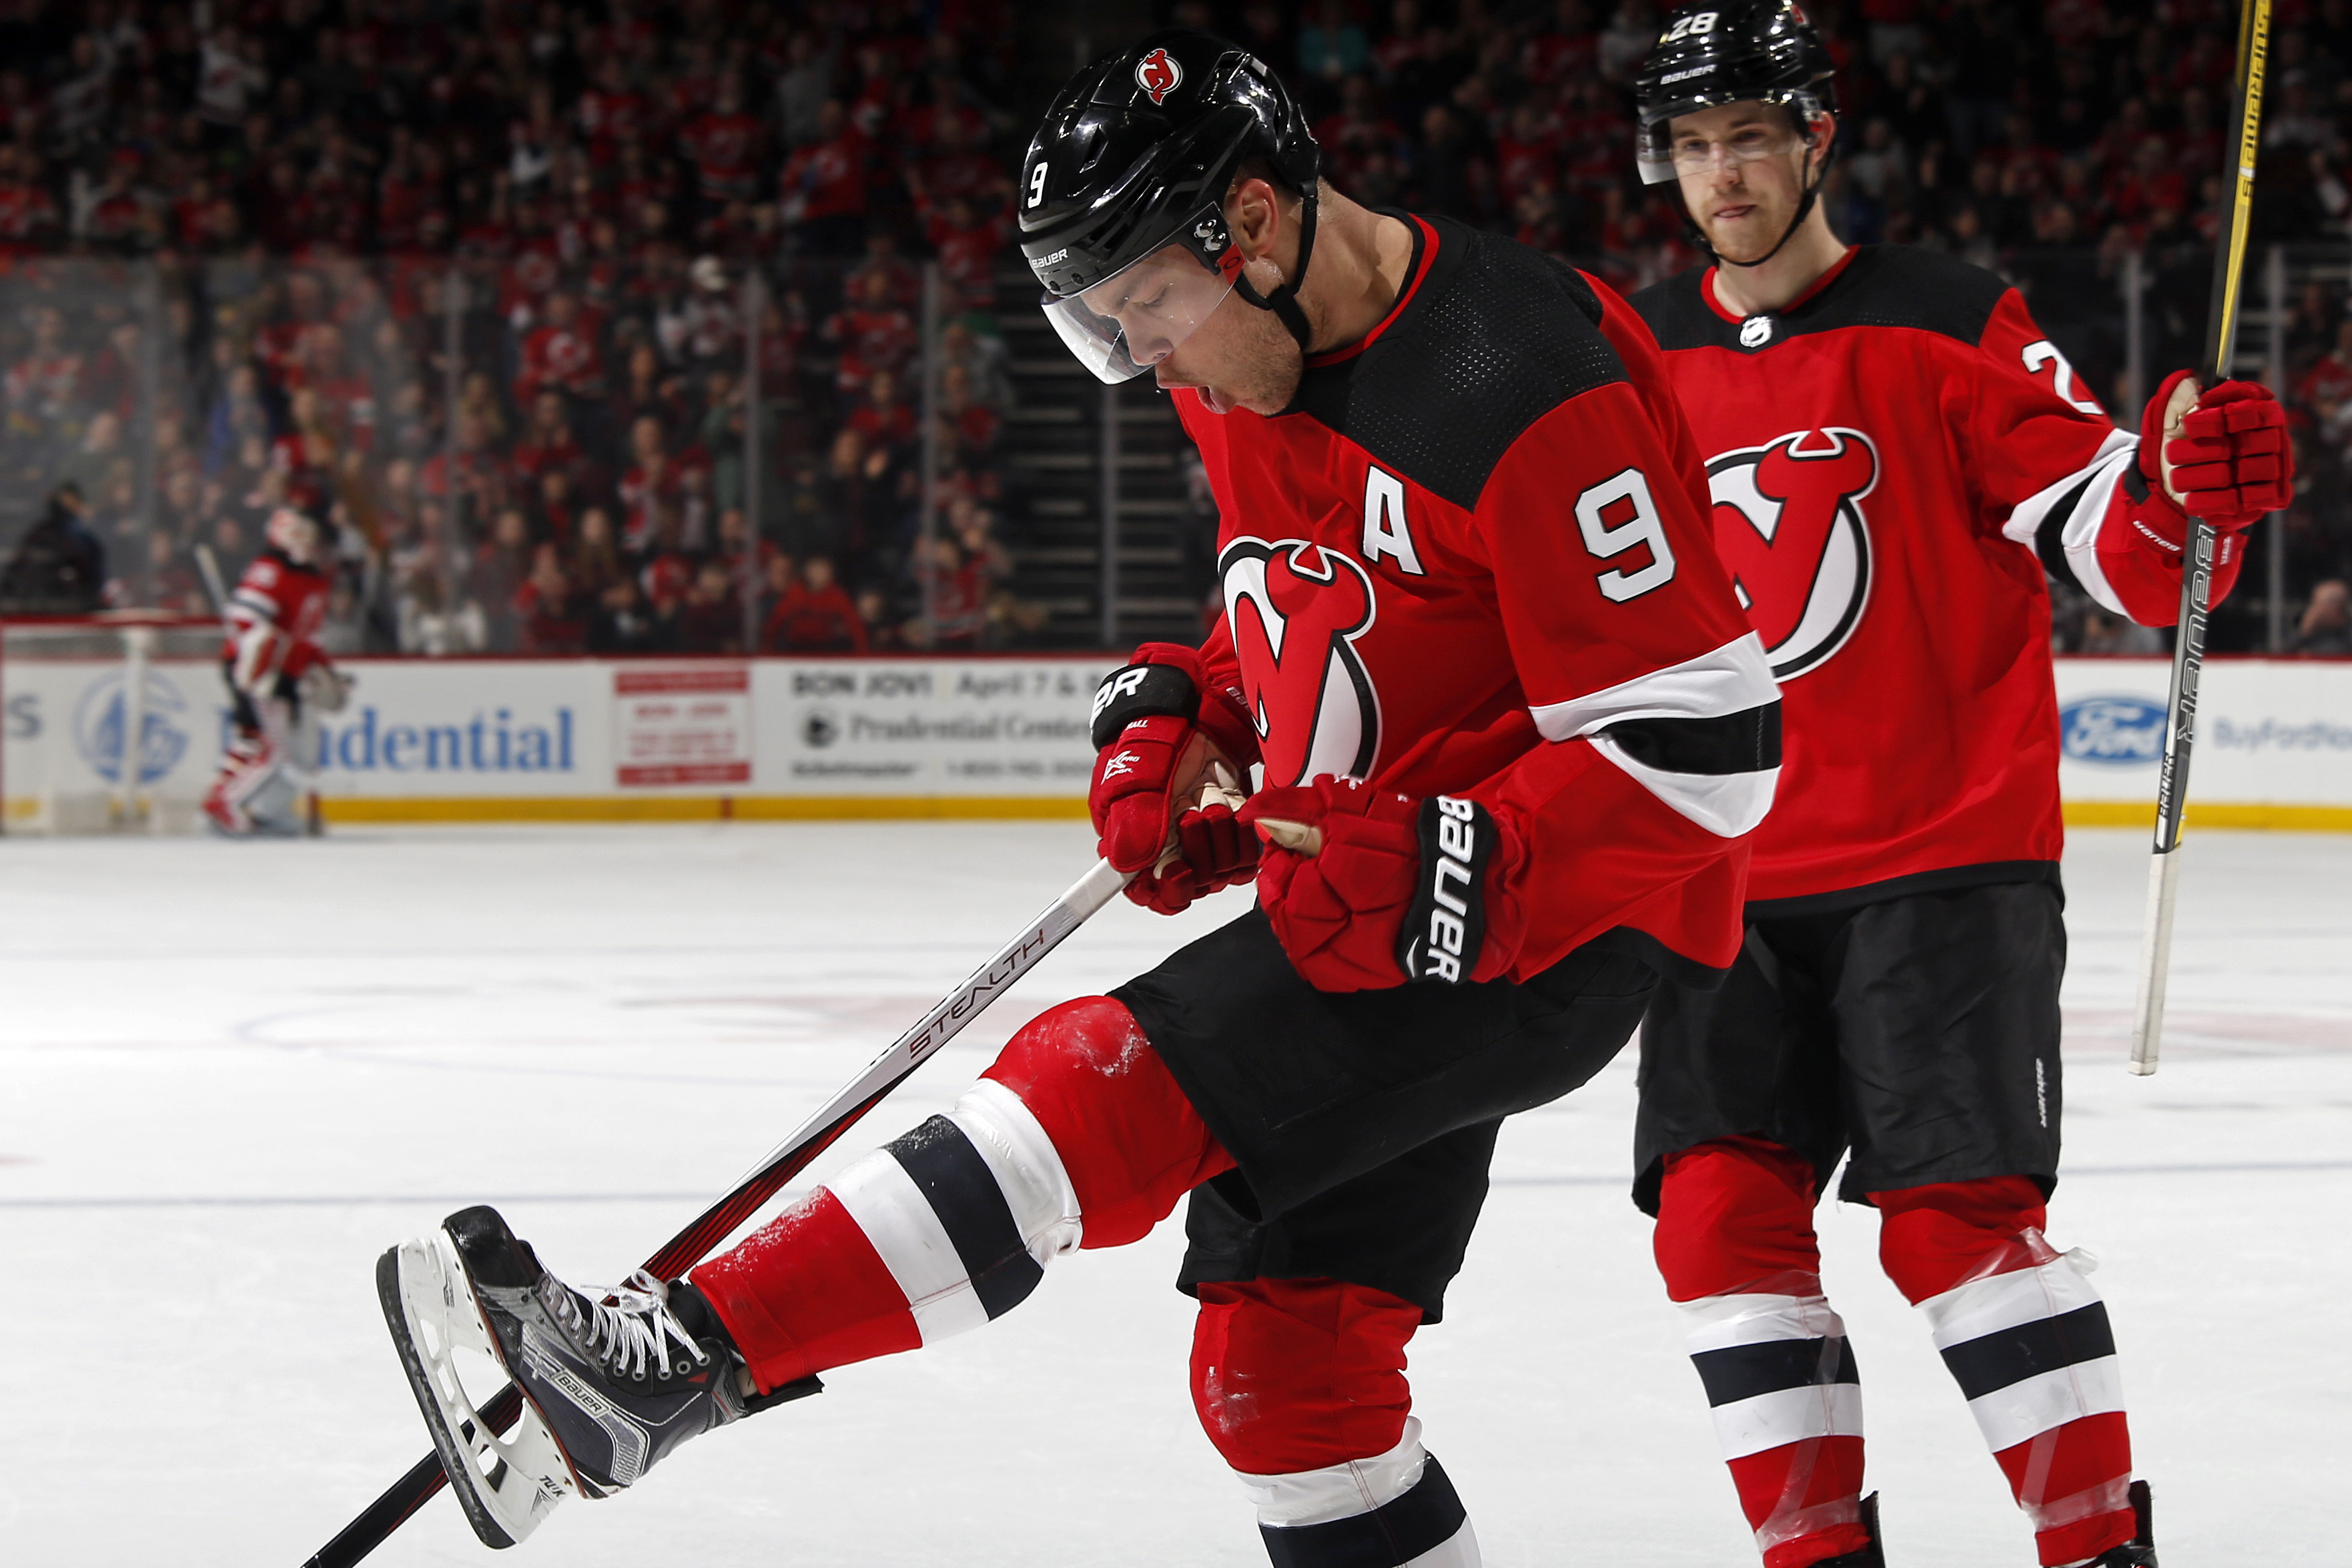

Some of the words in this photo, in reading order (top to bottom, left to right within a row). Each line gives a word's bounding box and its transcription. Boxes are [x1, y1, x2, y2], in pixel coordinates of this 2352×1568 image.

[1667, 11, 1719, 42] 28
[1659, 64, 1718, 85] BAUER
[1028, 161, 1048, 209] 9
[1031, 248, 1068, 268] BAUER
[2020, 339, 2104, 415] 2
[1362, 464, 1427, 576] A
[1573, 466, 1676, 604] 9
[2133, 520, 2182, 551] BAUER
[2177, 524, 2217, 743] BAUER
[955, 673, 1025, 700] April
[220, 705, 575, 772] dential
[849, 714, 1000, 741] Prudential
[2066, 705, 2167, 757] Ford
[1425, 795, 1475, 984] BAUER
[909, 928, 1044, 1061] STEALTH
[558, 1376, 603, 1413] BAUER
